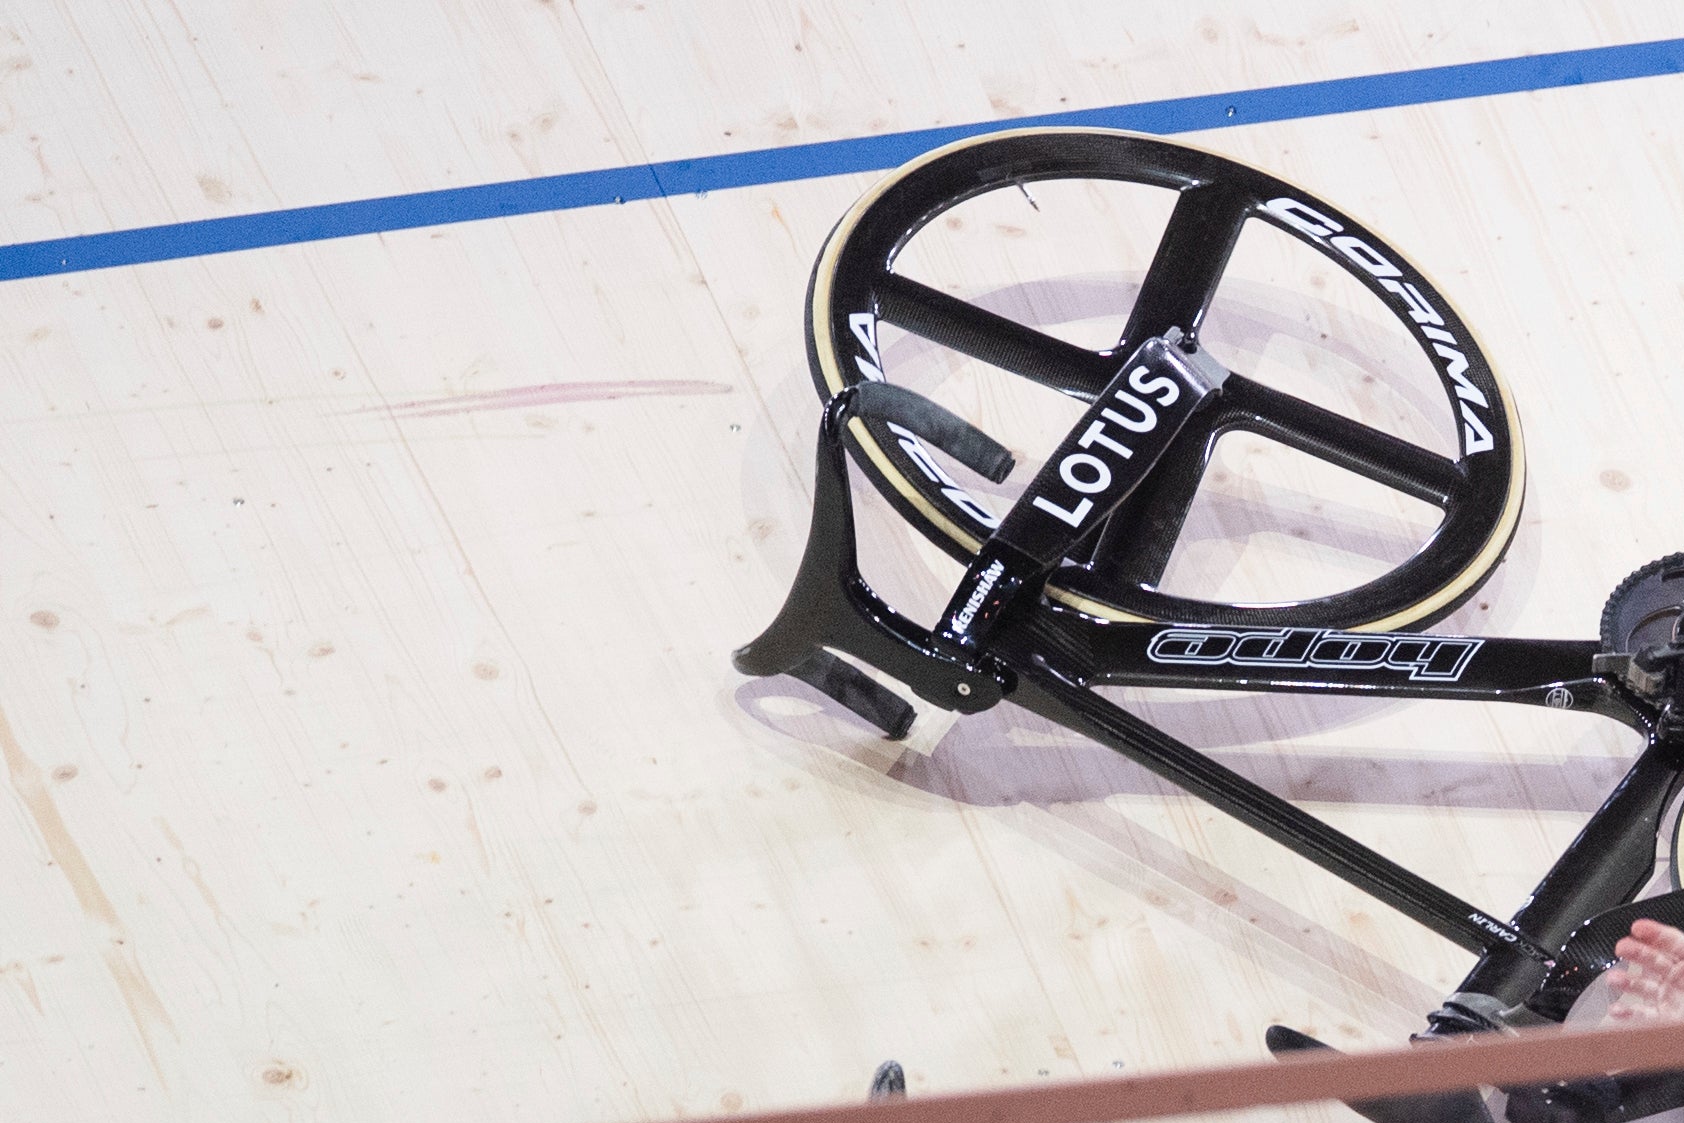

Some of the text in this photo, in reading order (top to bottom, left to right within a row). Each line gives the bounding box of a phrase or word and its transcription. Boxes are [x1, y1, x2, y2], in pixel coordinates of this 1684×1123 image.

[1266, 196, 1494, 454] CORIMA
[1033, 364, 1181, 528] LOTUS
[954, 560, 1005, 633] RENISHAW
[1146, 628, 1485, 682] hope
[1468, 912, 1518, 943] CARLIN
